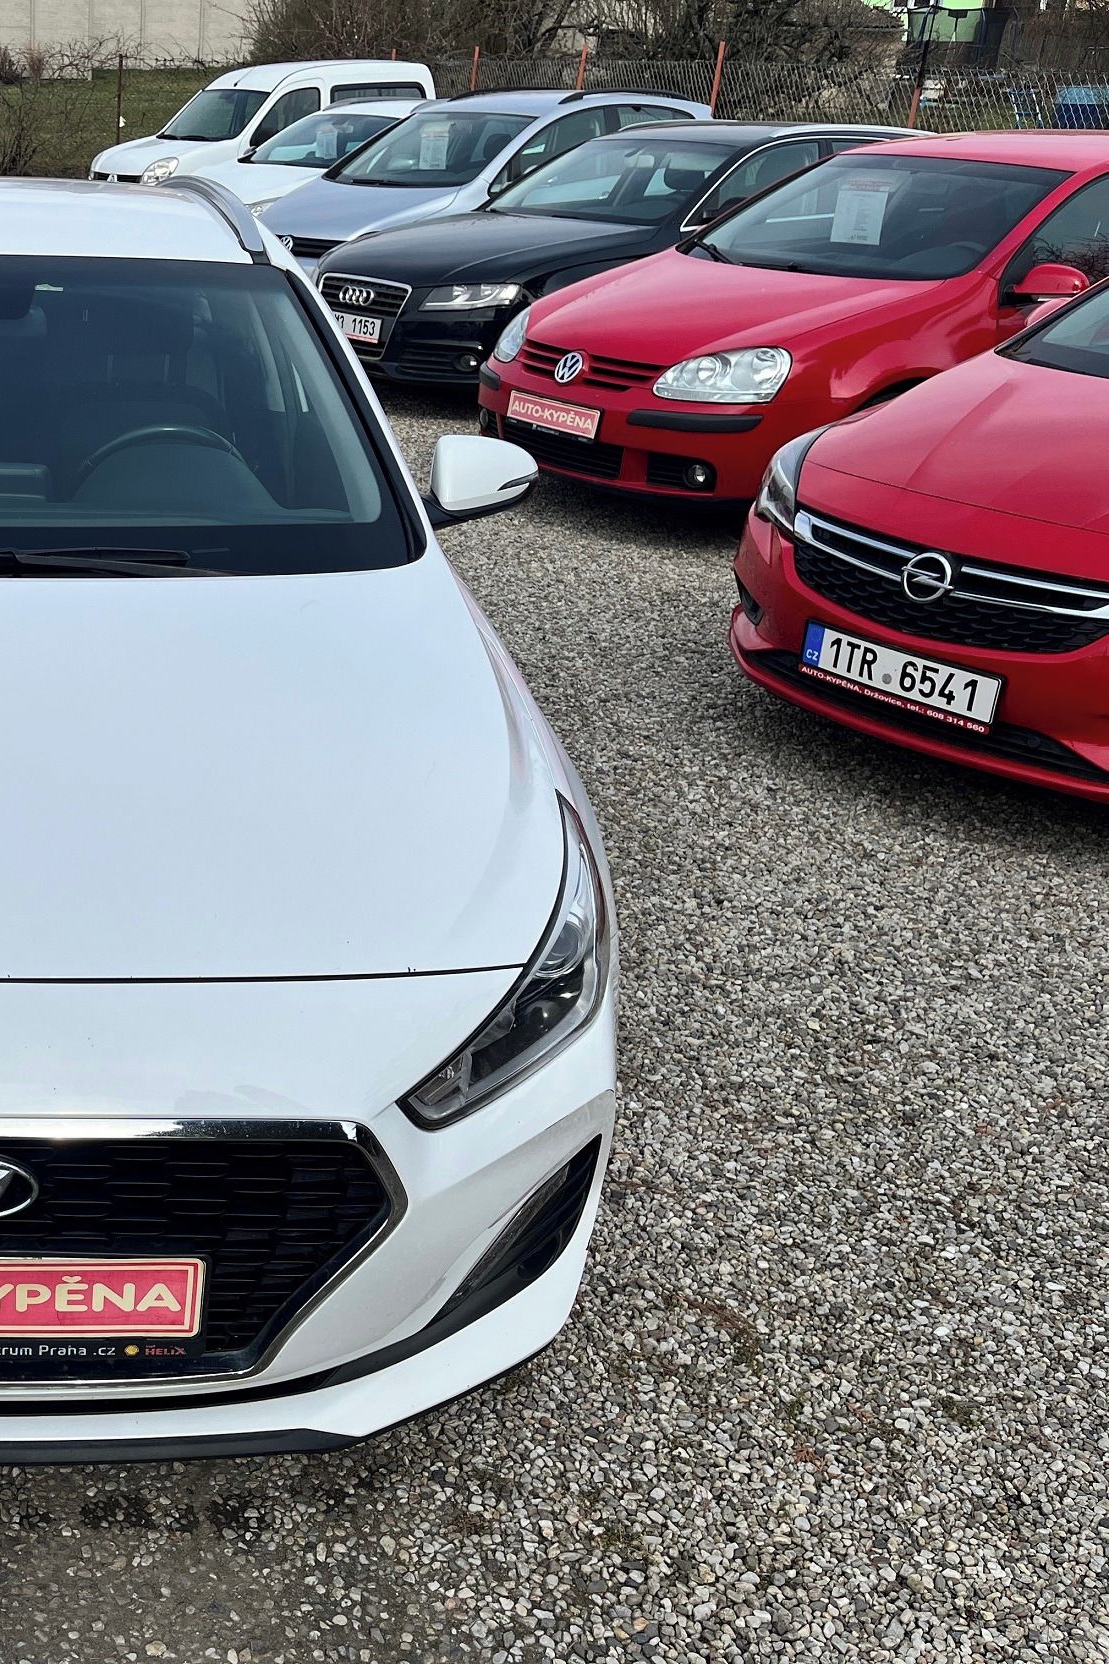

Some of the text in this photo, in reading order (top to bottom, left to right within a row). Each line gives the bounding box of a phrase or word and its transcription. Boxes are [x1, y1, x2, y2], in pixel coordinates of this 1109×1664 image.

[352, 318, 376, 336] 1153
[512, 400, 593, 430] AUTO-KYPĚNA
[806, 649, 819, 661] CZ
[830, 637, 979, 713] 1TR 6541
[926, 709, 944, 720] 608
[946, 716, 964, 726] 314
[39, 1345, 87, 1356] Praha
